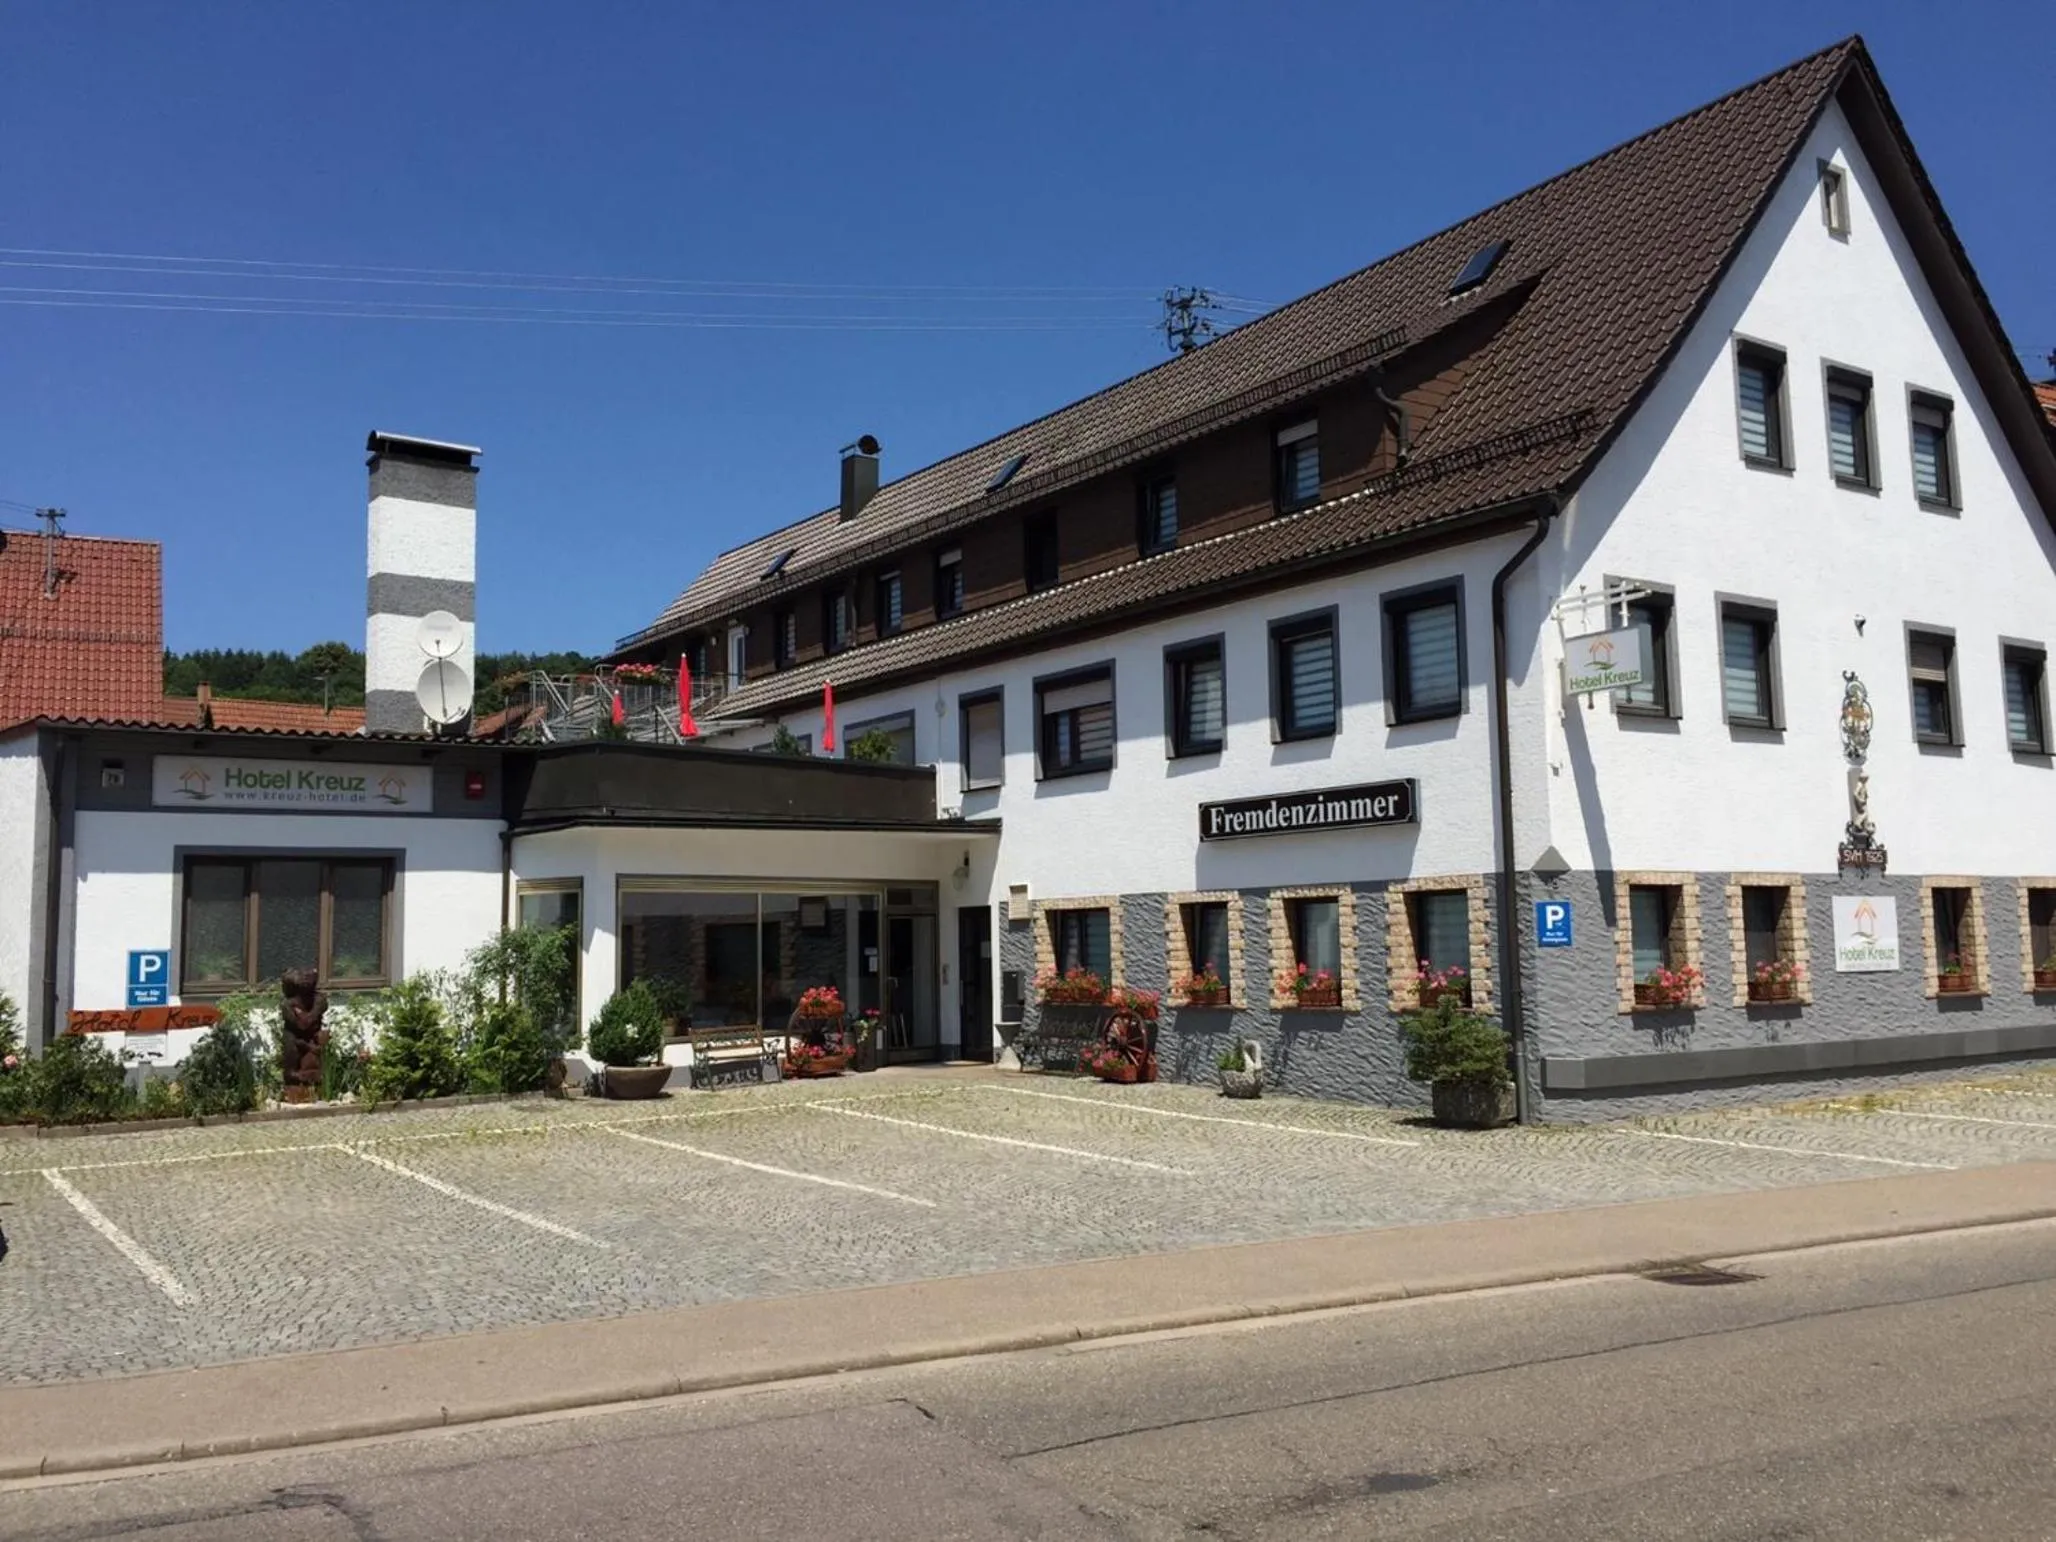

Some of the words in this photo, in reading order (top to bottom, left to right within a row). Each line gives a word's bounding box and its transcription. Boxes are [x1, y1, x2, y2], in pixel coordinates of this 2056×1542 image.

[1570, 674, 1602, 690] Hotel
[1604, 670, 1640, 684] Kreuz
[225, 767, 291, 790] Hotel
[299, 769, 366, 792] Kreuz
[223, 790, 366, 802] www.kreuz-hotel.de
[1209, 795, 1399, 834] Fremdenzimmer
[1545, 905, 1565, 930] P
[1840, 946, 1865, 961] Hotel
[1867, 947, 1896, 961] Kreuz
[139, 954, 162, 983] P
